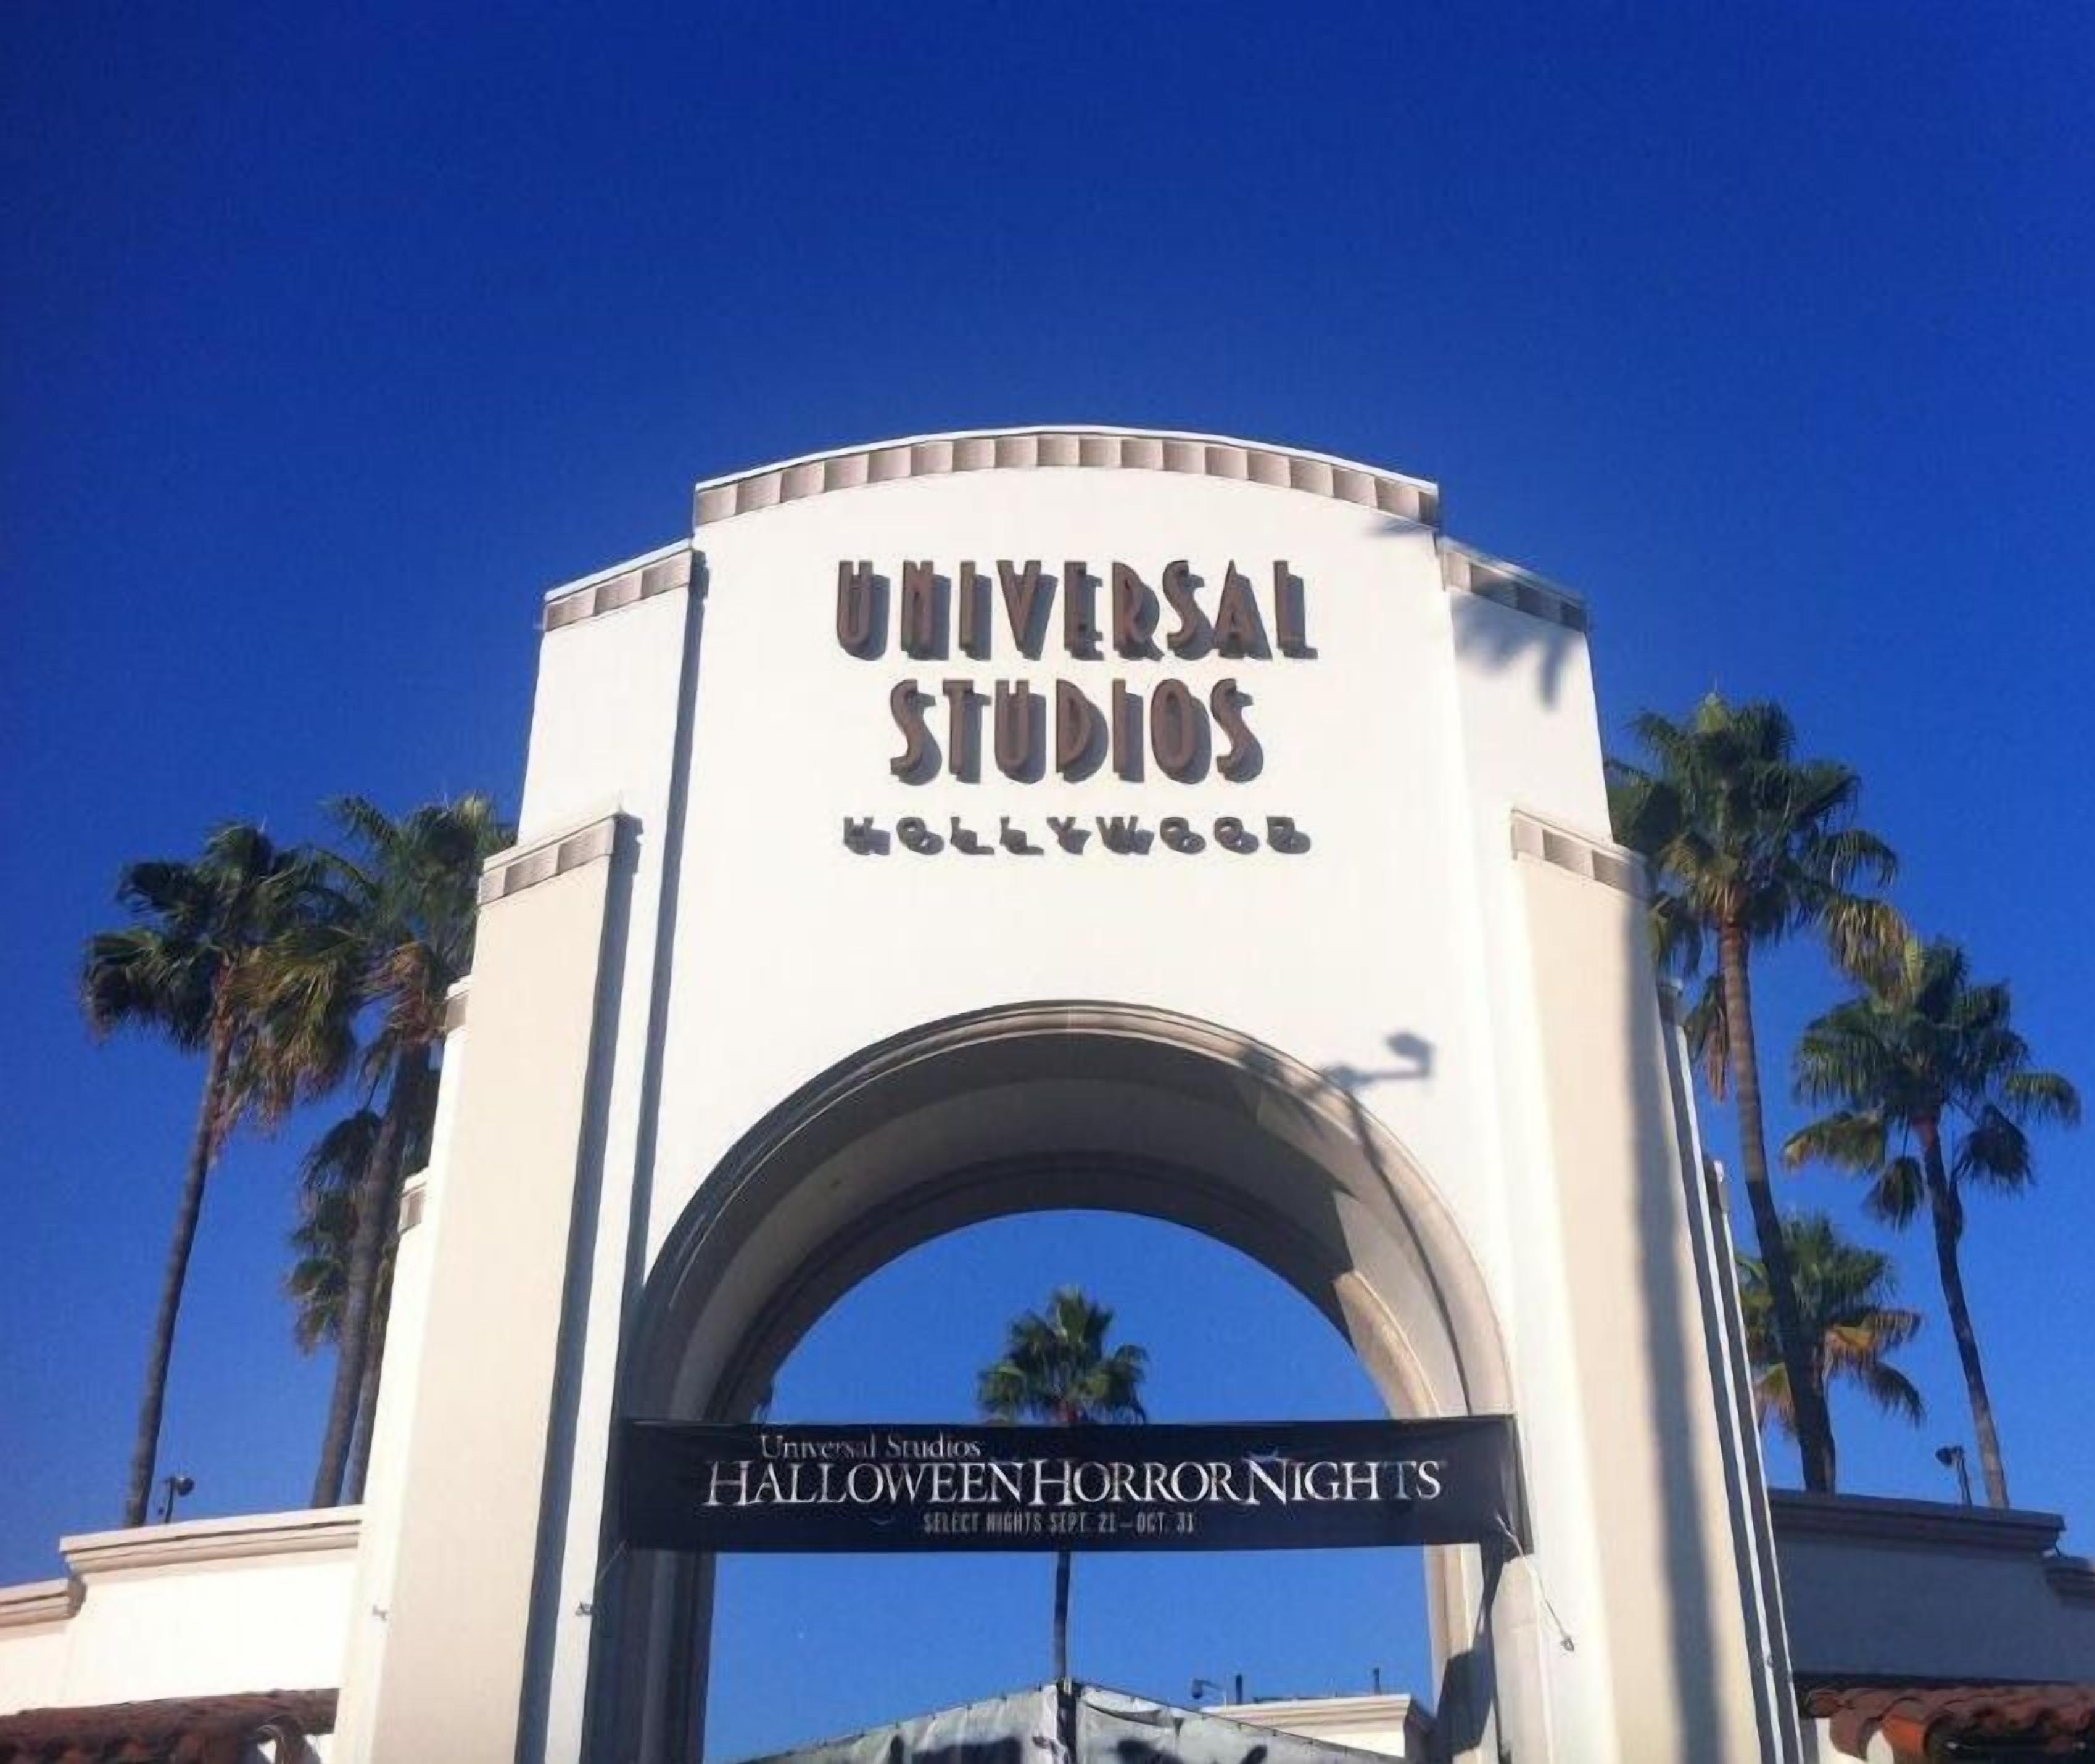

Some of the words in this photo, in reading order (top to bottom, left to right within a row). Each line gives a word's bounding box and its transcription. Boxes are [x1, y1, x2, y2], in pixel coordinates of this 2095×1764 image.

[836, 560, 1318, 661] UNIVERSAL
[890, 678, 1264, 785] STUDIOS
[843, 815, 1312, 856] HOLLYWOOD
[761, 1432, 876, 1459] Universal
[886, 1431, 982, 1459] Studios
[923, 1511, 980, 1534] SELECT
[987, 1510, 1042, 1535] NIGHTS
